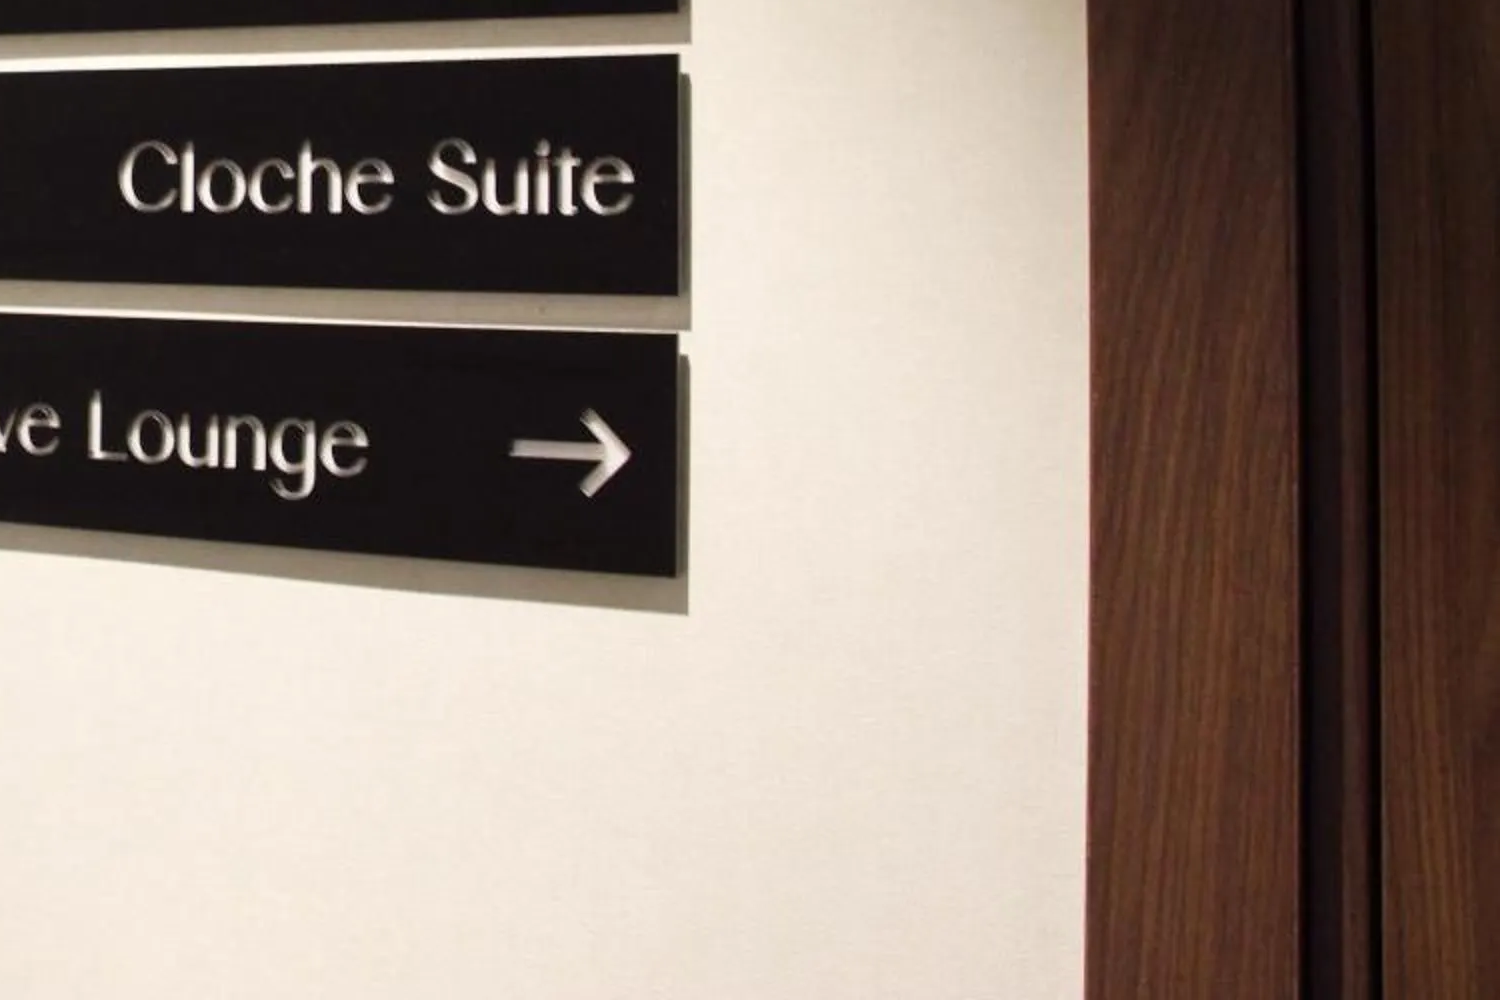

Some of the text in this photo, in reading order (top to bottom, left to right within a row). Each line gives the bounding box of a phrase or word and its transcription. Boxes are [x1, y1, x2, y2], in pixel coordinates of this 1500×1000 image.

[117, 138, 636, 217] Cloche Suite
[87, 390, 370, 501] Lounge
